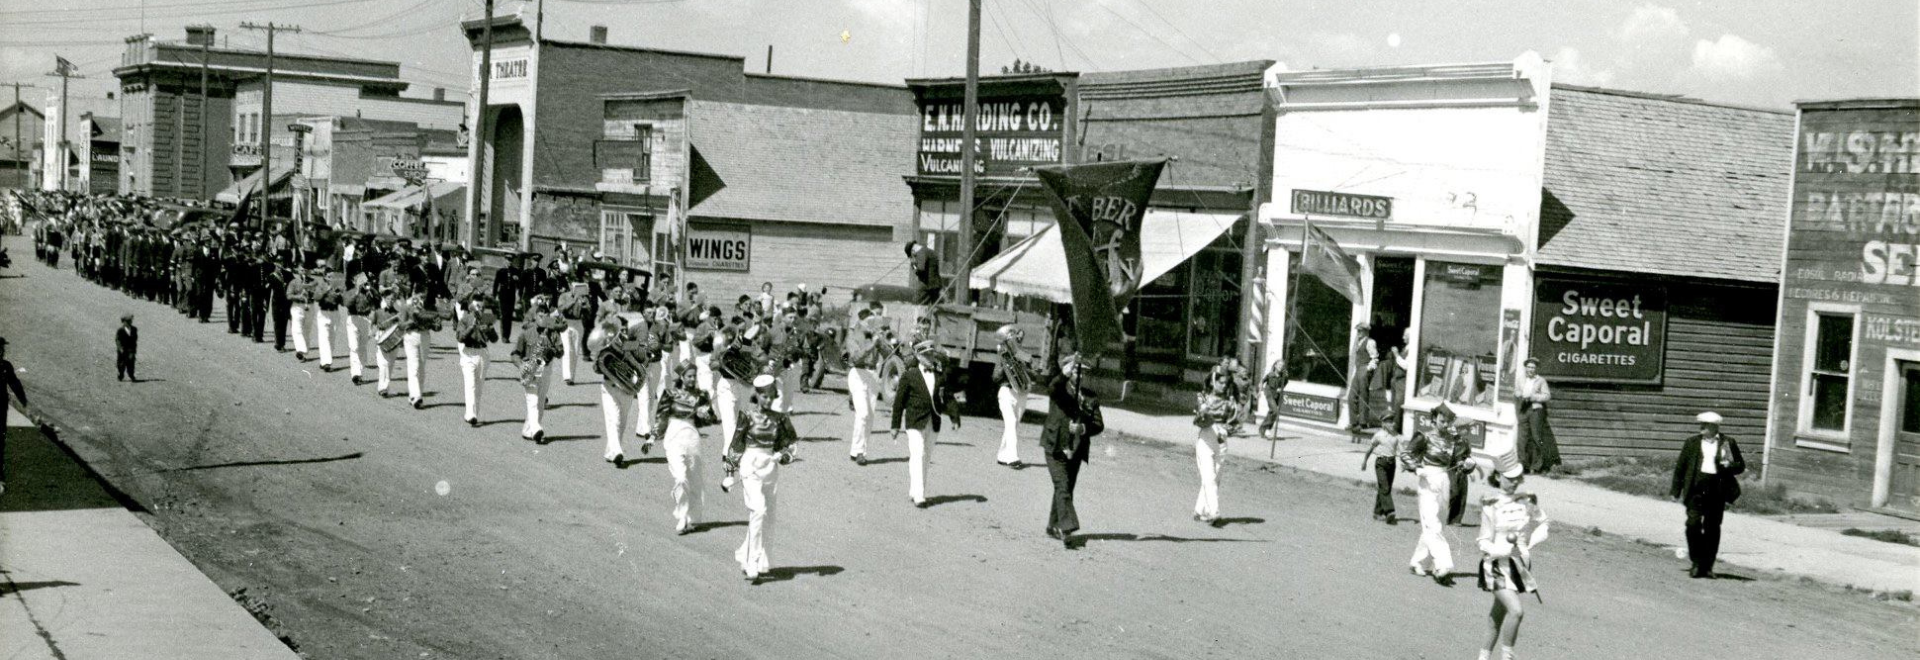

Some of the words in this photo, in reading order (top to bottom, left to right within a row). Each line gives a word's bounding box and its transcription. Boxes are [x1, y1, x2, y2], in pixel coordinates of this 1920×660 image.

[495, 60, 528, 79] THEATRE
[924, 102, 1021, 131] E.N.HDING
[1027, 101, 1059, 131] CO.
[922, 137, 981, 153] HARNES
[990, 137, 1060, 162] VULCANIZING
[393, 160, 425, 170] COFFEE
[1065, 194, 1137, 231] TBER
[1300, 192, 1387, 218] BILLIARDS
[690, 238, 746, 261] WINGS
[1862, 240, 1920, 286] SE
[1562, 290, 1643, 319] Sweet
[1547, 316, 1650, 350] Caporal
[1558, 352, 1636, 366] CIGARETTES
[1283, 394, 1305, 408] Sweet
[1305, 397, 1334, 412] Caporal
